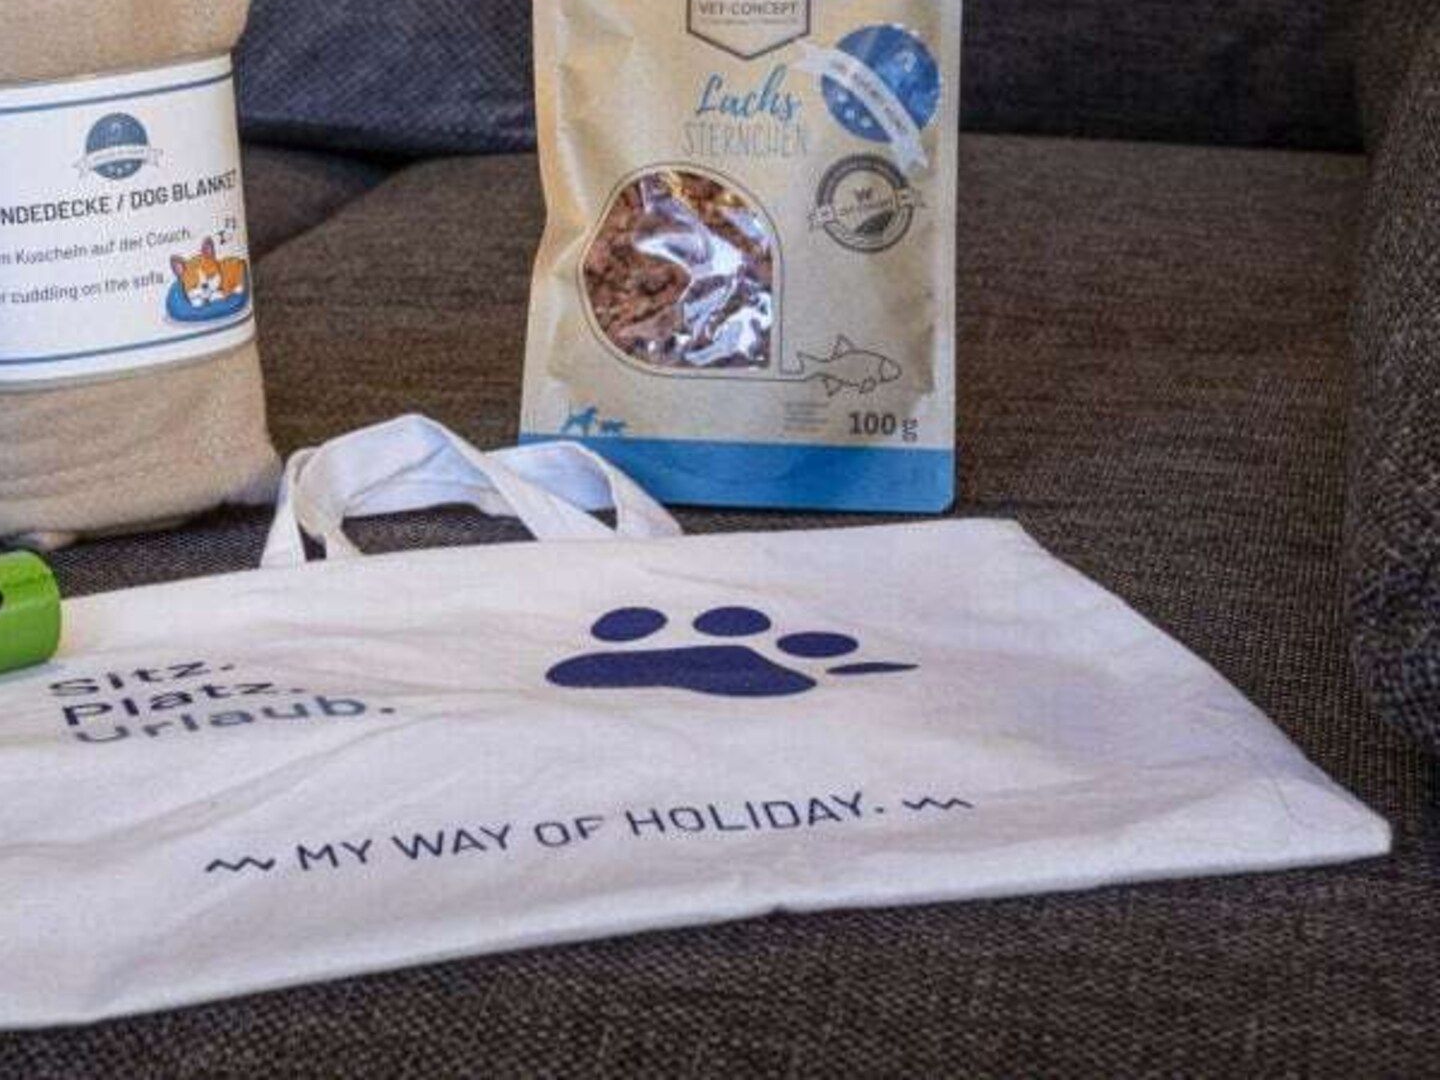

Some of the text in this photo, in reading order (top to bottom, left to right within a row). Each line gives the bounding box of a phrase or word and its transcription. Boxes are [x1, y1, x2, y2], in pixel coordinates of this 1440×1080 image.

[130, 186, 169, 211] DOG
[90, 240, 116, 256] auf
[10, 280, 79, 305] cuddling
[81, 283, 101, 297] on
[104, 277, 130, 293] the
[848, 410, 897, 436] 100
[901, 418, 918, 442] g
[48, 660, 236, 698] Sitz.
[61, 681, 306, 727] Platz.
[74, 695, 396, 744] Urlaub.
[296, 791, 886, 871] MY WAY OF HOLIDAY.
